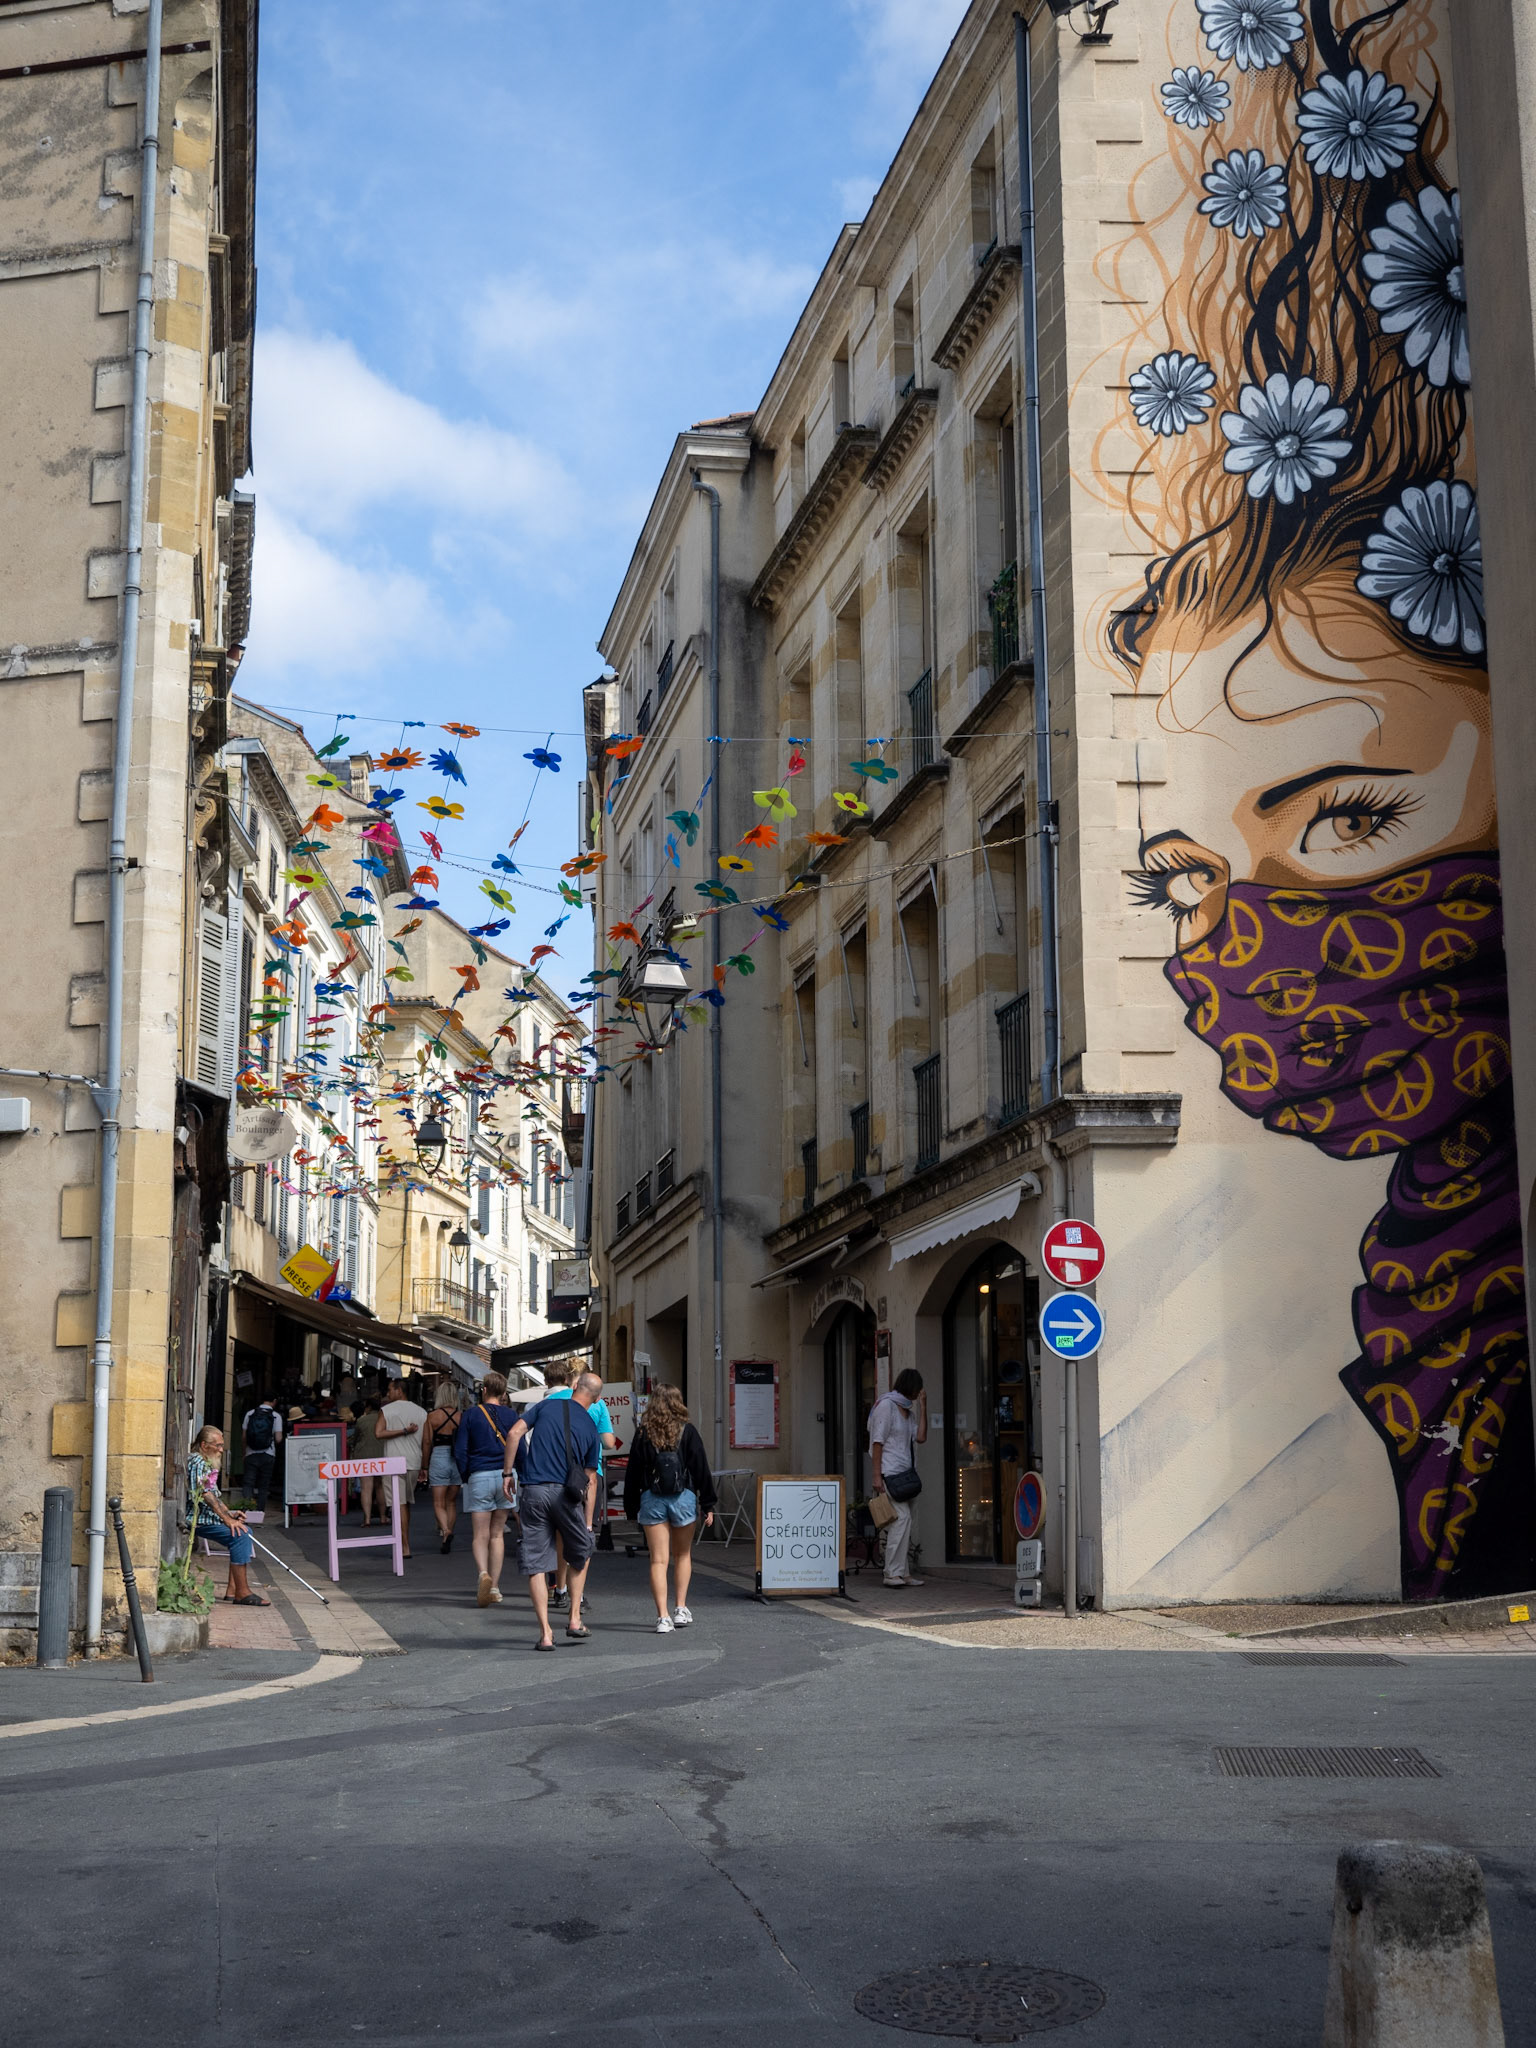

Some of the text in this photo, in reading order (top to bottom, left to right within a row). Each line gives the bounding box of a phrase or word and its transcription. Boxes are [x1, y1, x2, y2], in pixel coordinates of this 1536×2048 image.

[242, 1115, 277, 1126] Artisan
[235, 1124, 285, 1136] Boulanger
[284, 1266, 312, 1293] PRESSE
[331, 1461, 387, 1477] OUVERT
[765, 1508, 783, 1520] LES
[765, 1523, 834, 1538] CRÉATEURS
[765, 1544, 837, 1559] DU COIN
[1022, 1547, 1031, 1556] DES
